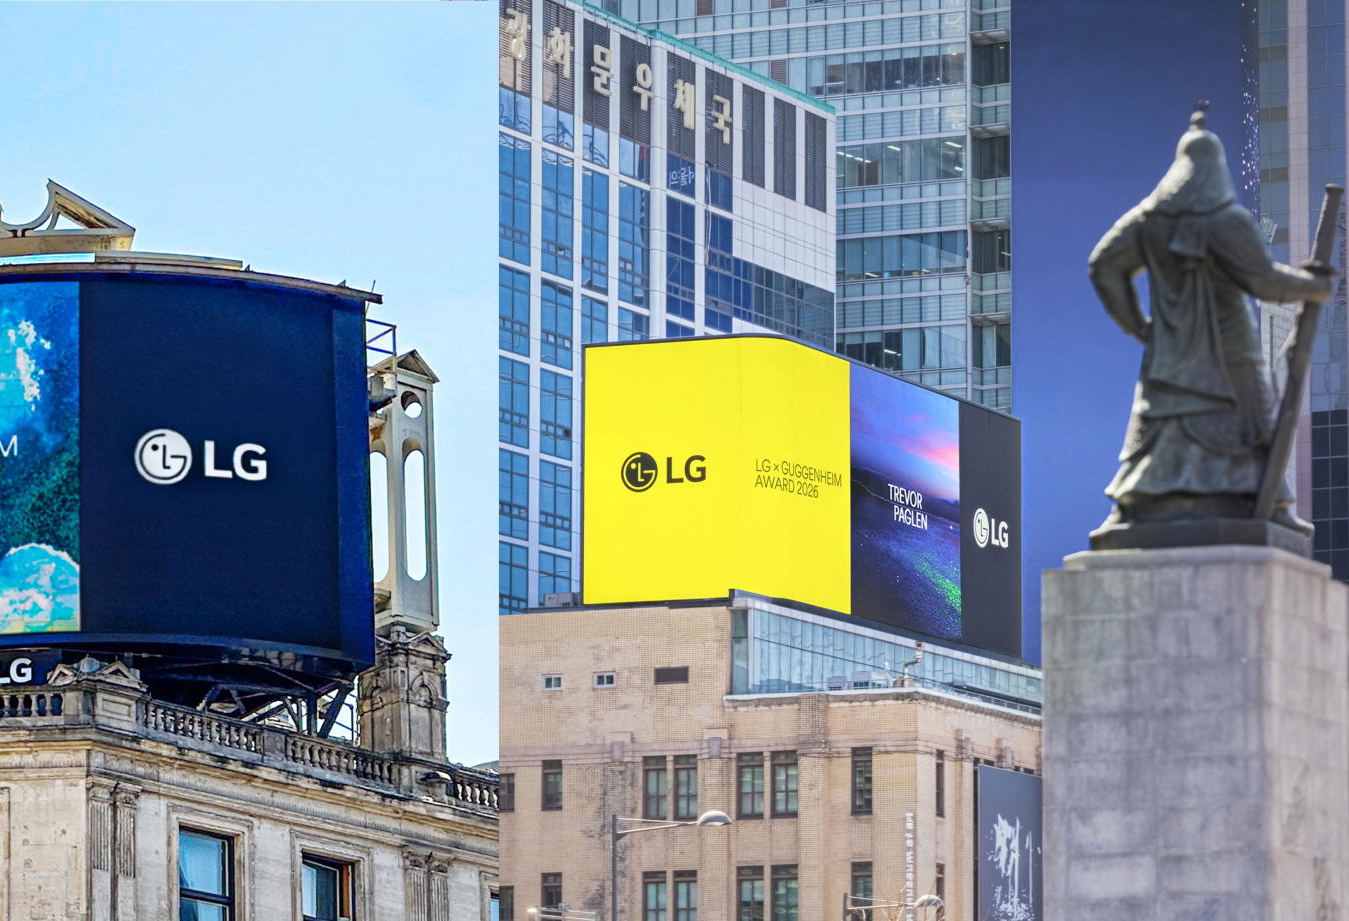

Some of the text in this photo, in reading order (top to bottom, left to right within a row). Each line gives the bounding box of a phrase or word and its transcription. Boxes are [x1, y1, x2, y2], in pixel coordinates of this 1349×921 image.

[506, 8, 733, 145] 광화문우체국
[204, 440, 268, 481] LG
[666, 455, 707, 484] LG
[755, 458, 771, 473] LG
[781, 460, 842, 488] GUGGENHEIM
[754, 474, 819, 499] AWARD 2026
[888, 483, 923, 510] TREVOR
[893, 504, 928, 530] PAGLEN
[991, 518, 1009, 548] LG
